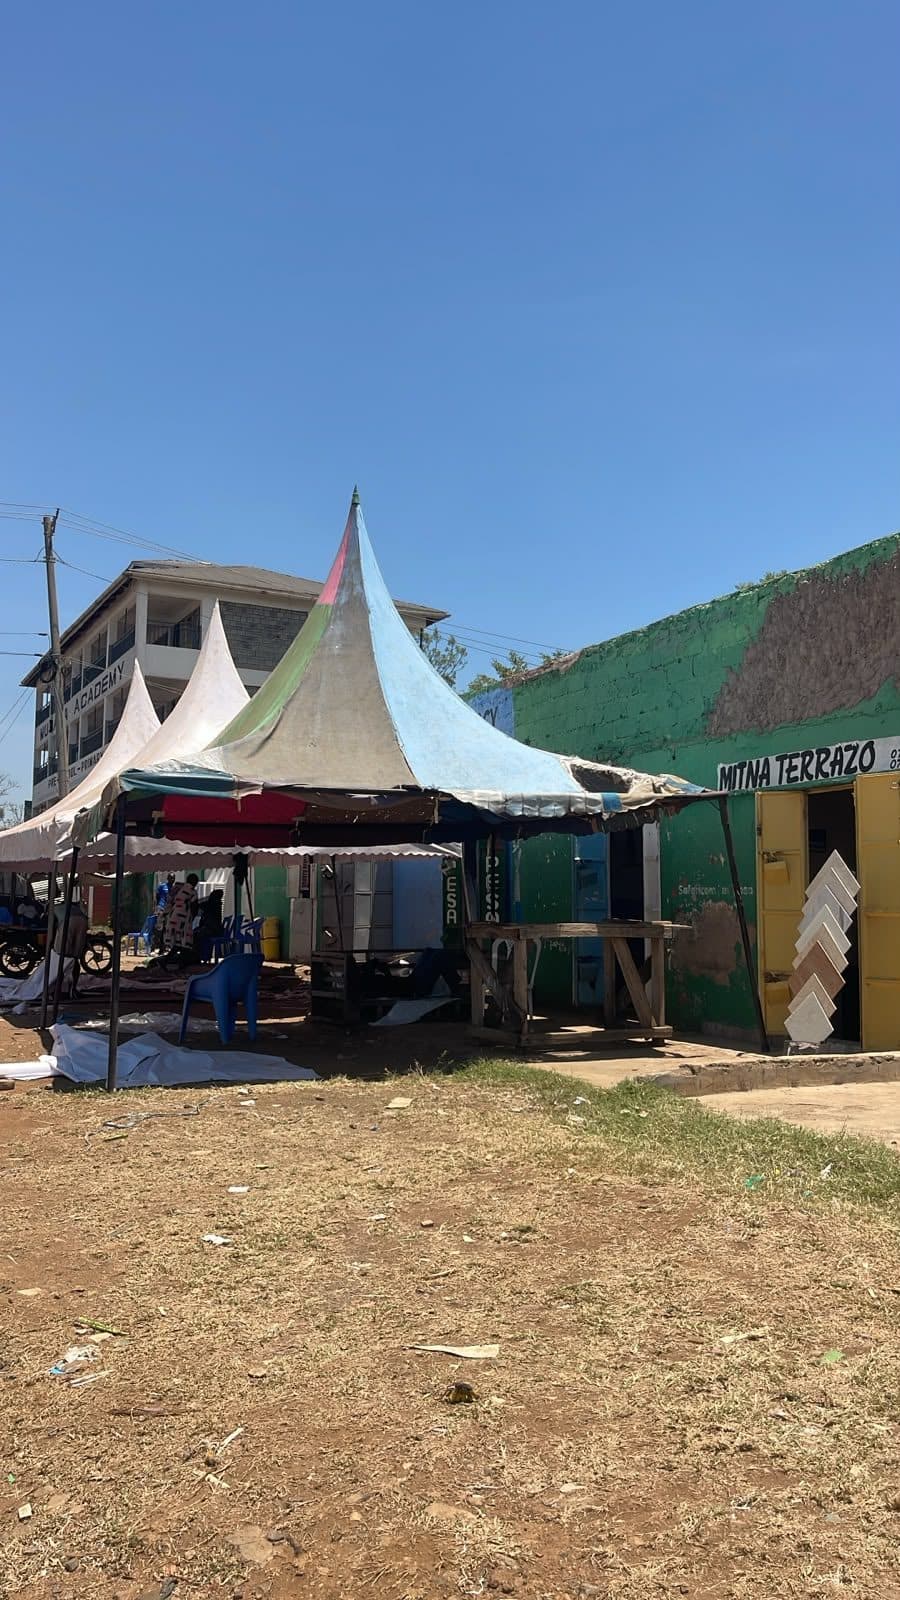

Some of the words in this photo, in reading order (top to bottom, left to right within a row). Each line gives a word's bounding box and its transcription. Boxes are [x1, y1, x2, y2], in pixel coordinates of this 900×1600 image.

[74, 661, 125, 714] ACADEMY
[719, 757, 770, 791] MITNA
[776, 741, 875, 784] TERRAZO
